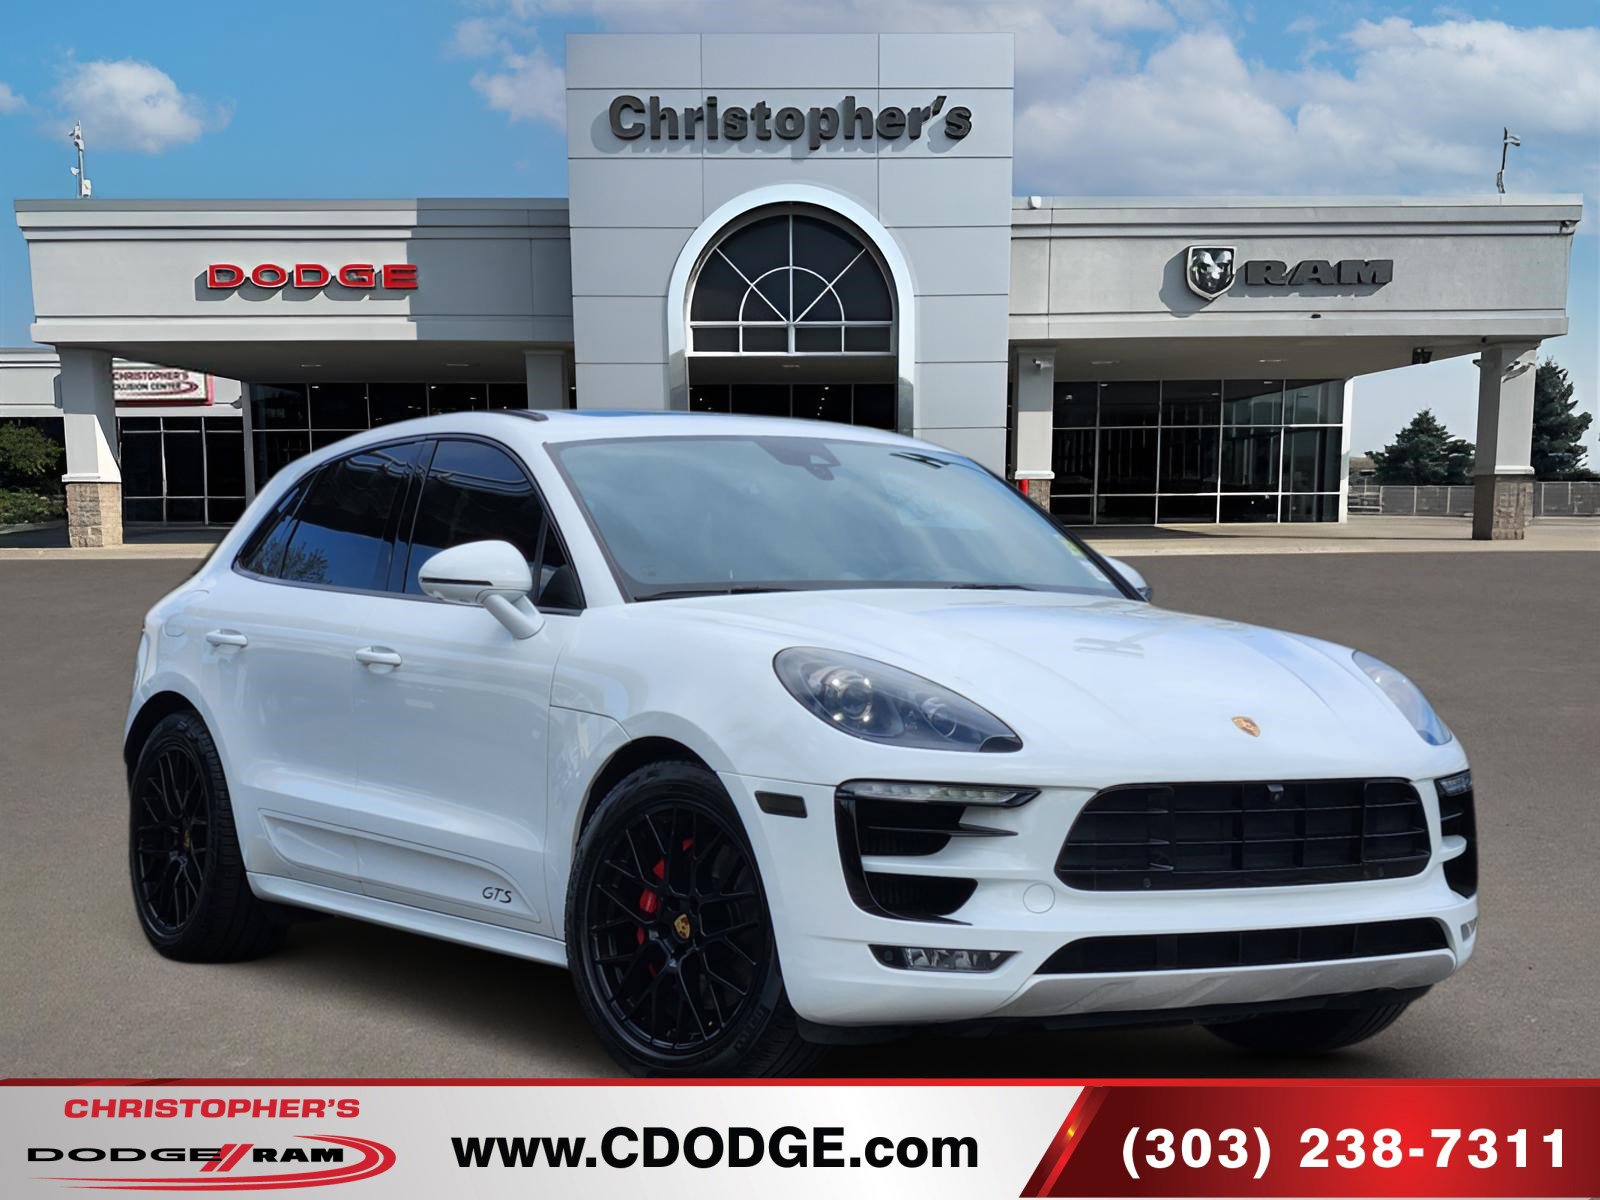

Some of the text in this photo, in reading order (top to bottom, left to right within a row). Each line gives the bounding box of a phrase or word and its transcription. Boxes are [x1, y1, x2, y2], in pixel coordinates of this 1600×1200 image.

[608, 95, 972, 150] Christopher's
[207, 264, 418, 289] DODGE
[1245, 260, 1393, 285] RAM
[150, 382, 180, 390] CENTER
[482, 886, 512, 904] GTS
